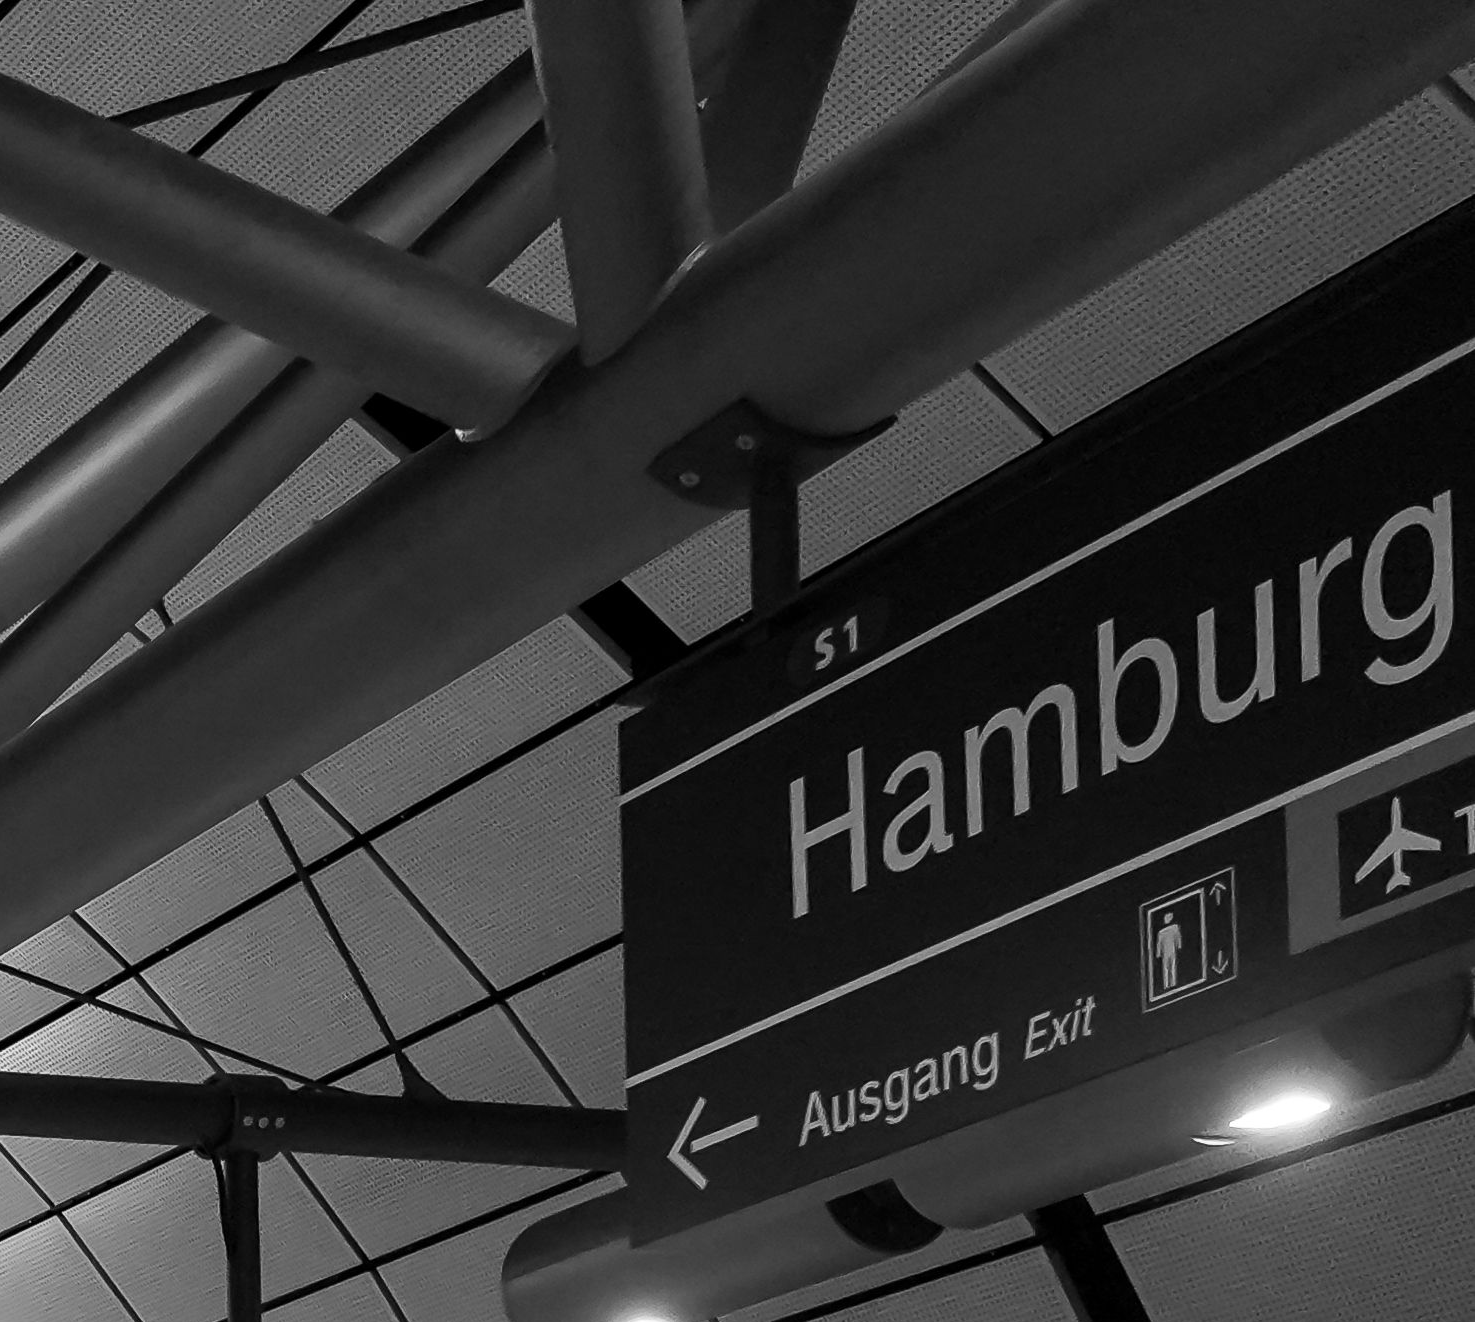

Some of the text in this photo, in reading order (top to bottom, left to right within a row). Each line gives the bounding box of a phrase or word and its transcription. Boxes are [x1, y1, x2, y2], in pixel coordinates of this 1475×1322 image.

[789, 489, 1455, 920] Hamburg
[798, 994, 1098, 1147] Ausgang Exit
